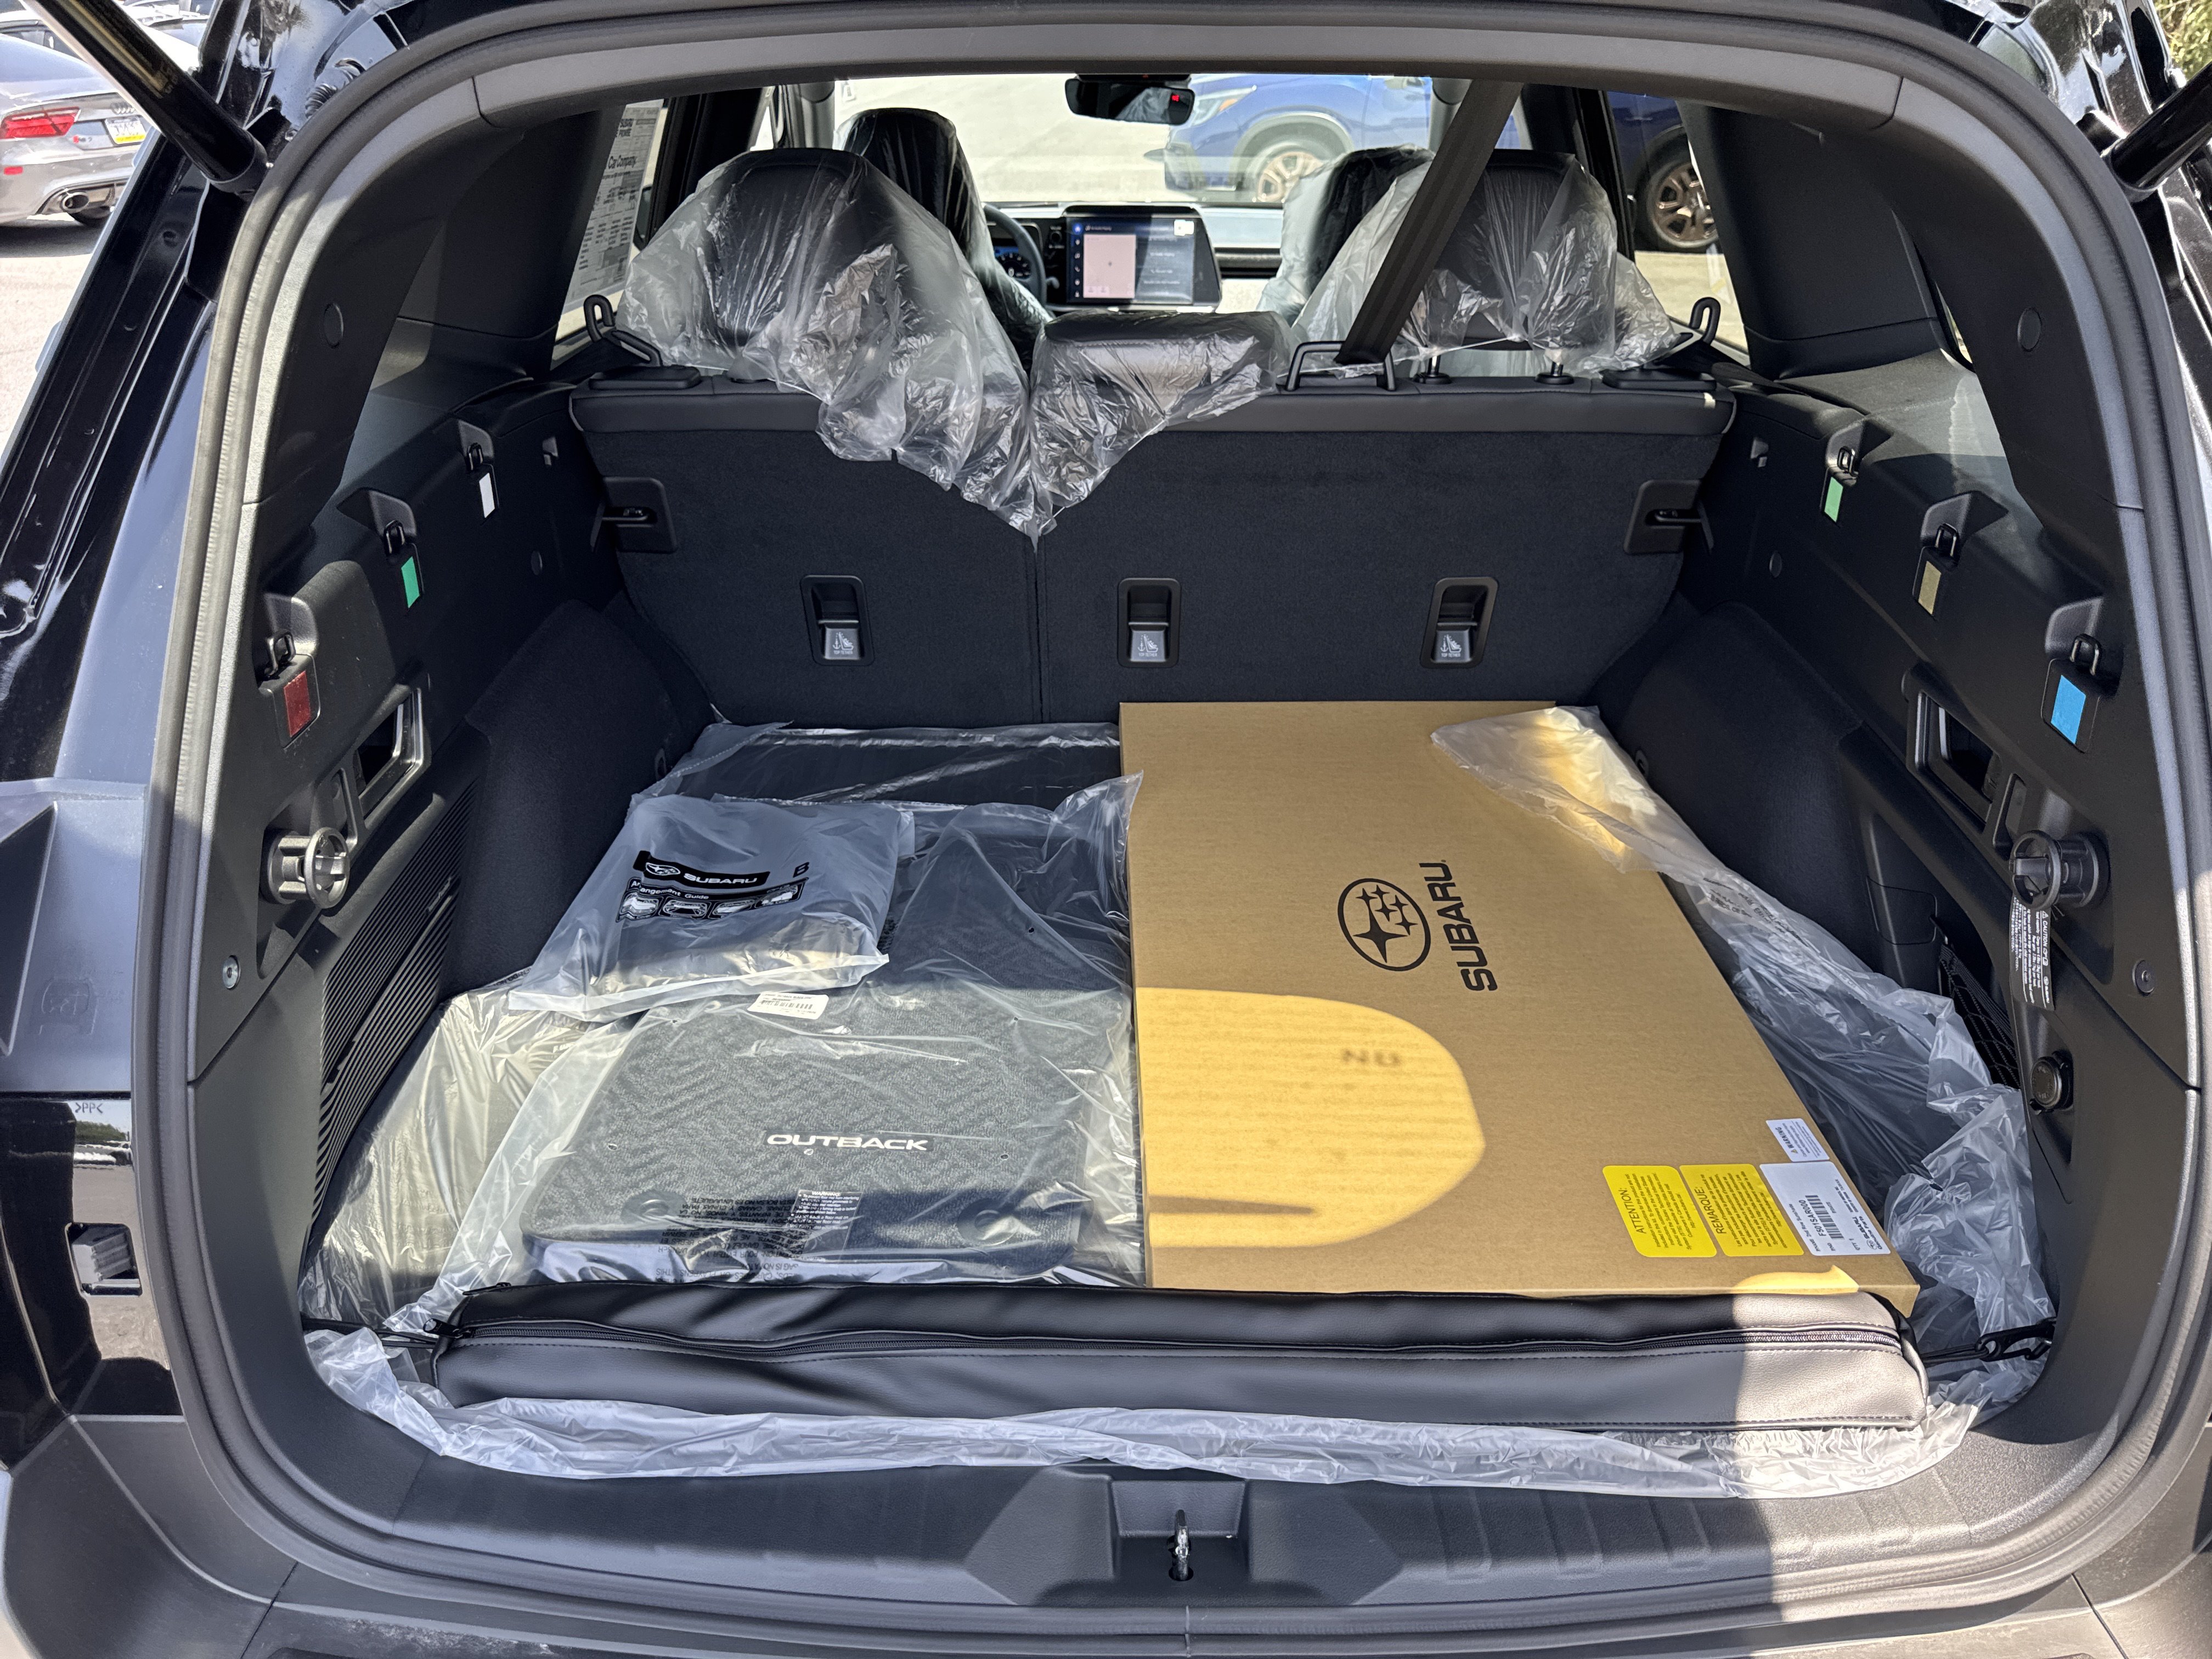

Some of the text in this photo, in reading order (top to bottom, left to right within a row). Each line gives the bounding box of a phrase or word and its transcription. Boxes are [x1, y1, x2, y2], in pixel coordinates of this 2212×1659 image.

[683, 872, 758, 884] SUBARU
[793, 862, 810, 878] B
[1419, 862, 1498, 992] SUBARU
[766, 1134, 929, 1151] OUTBACK
[1775, 1127, 1794, 1148] WARNING
[1618, 1187, 1646, 1234] ATTENTION:
[1694, 1186, 1726, 1233] REMARQUE:
[1788, 1203, 1802, 1221] Sunshade
[1798, 1200, 1826, 1236] F501SAR000
[1852, 1216, 1870, 1239] SUBARU
[1859, 1216, 1882, 1249] Genuine Parts
[656, 1268, 671, 1276] THIS
